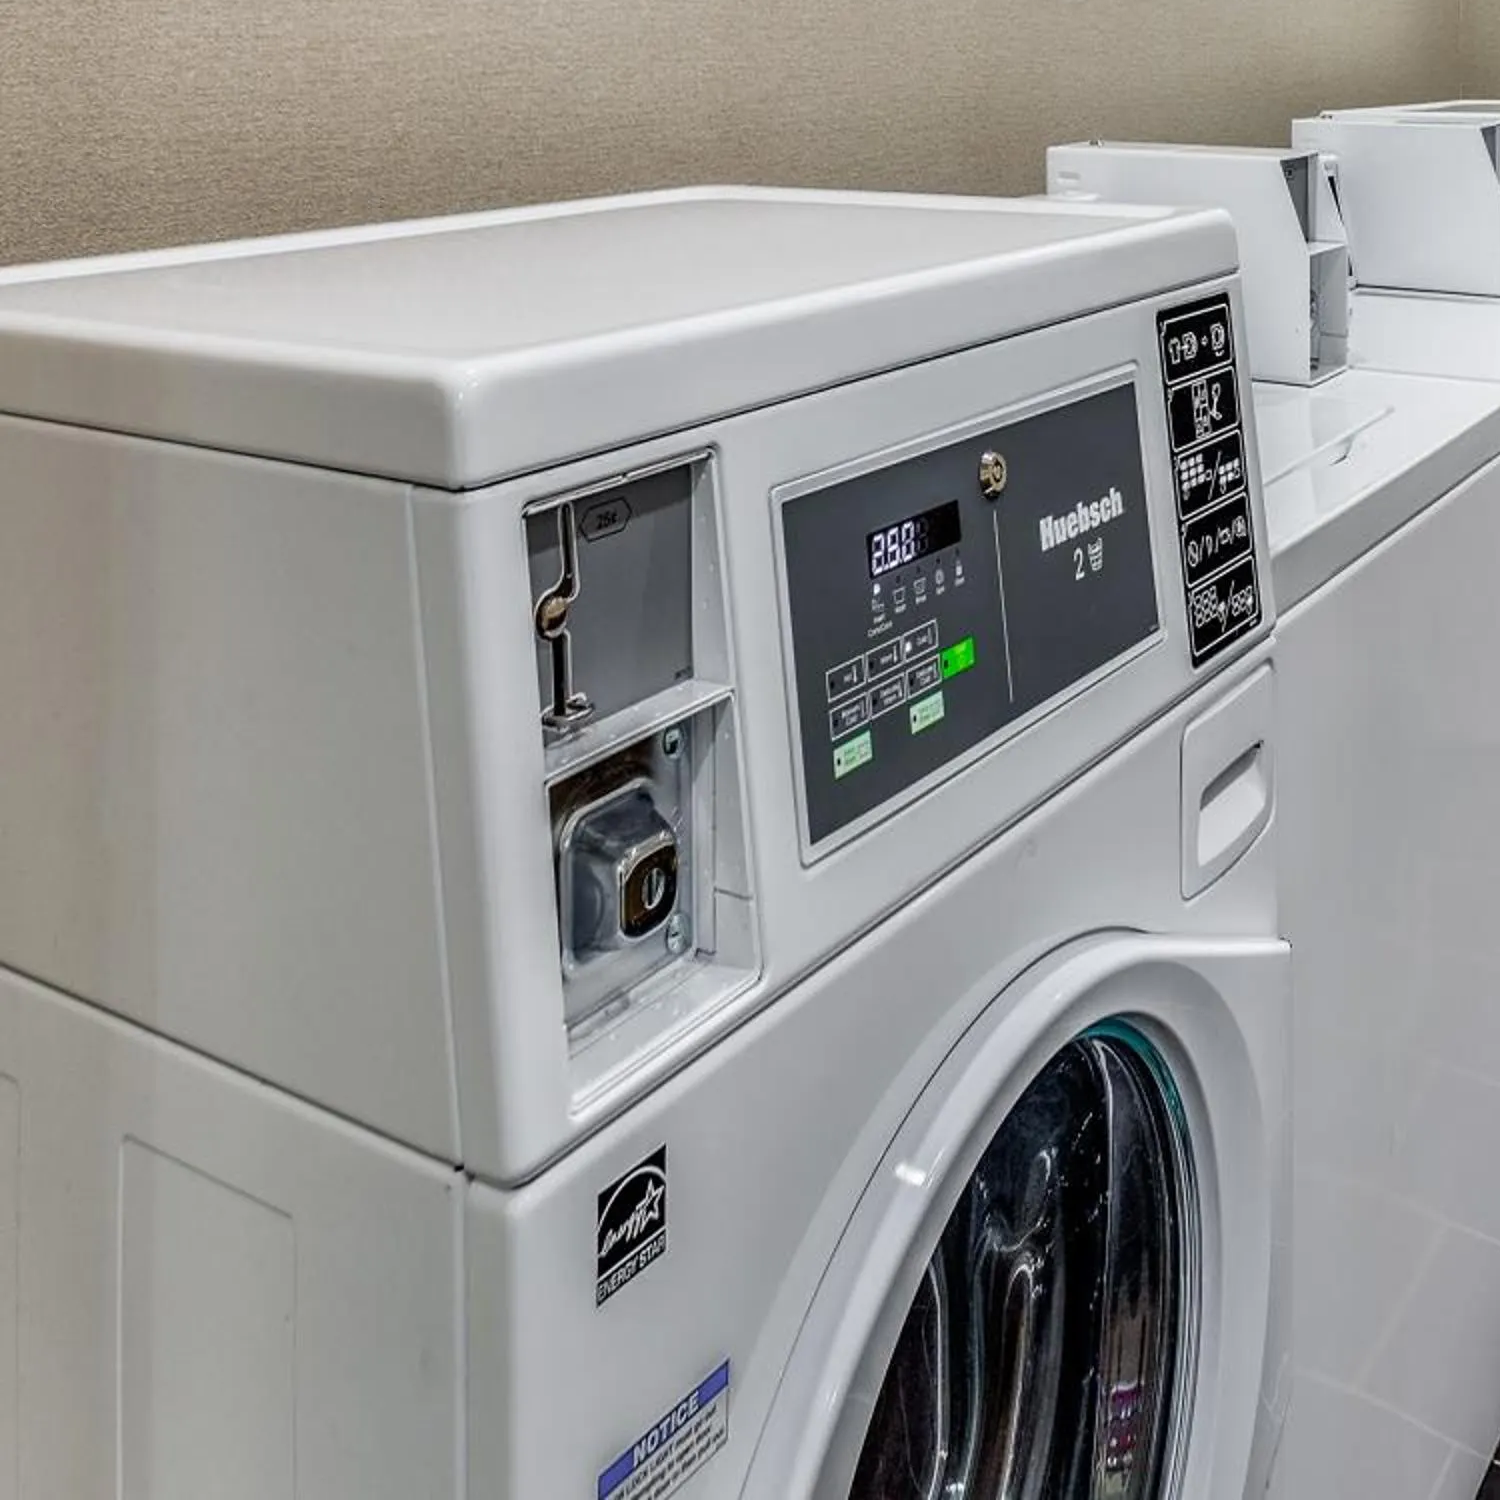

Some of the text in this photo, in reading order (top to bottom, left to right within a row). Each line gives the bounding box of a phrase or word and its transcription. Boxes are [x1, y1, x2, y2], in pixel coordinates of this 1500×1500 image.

[1039, 486, 1123, 552] Huebsch
[1073, 547, 1085, 581] 2
[598, 1234, 666, 1302] ENERGY STAR
[633, 1390, 699, 1467] NOTICE
